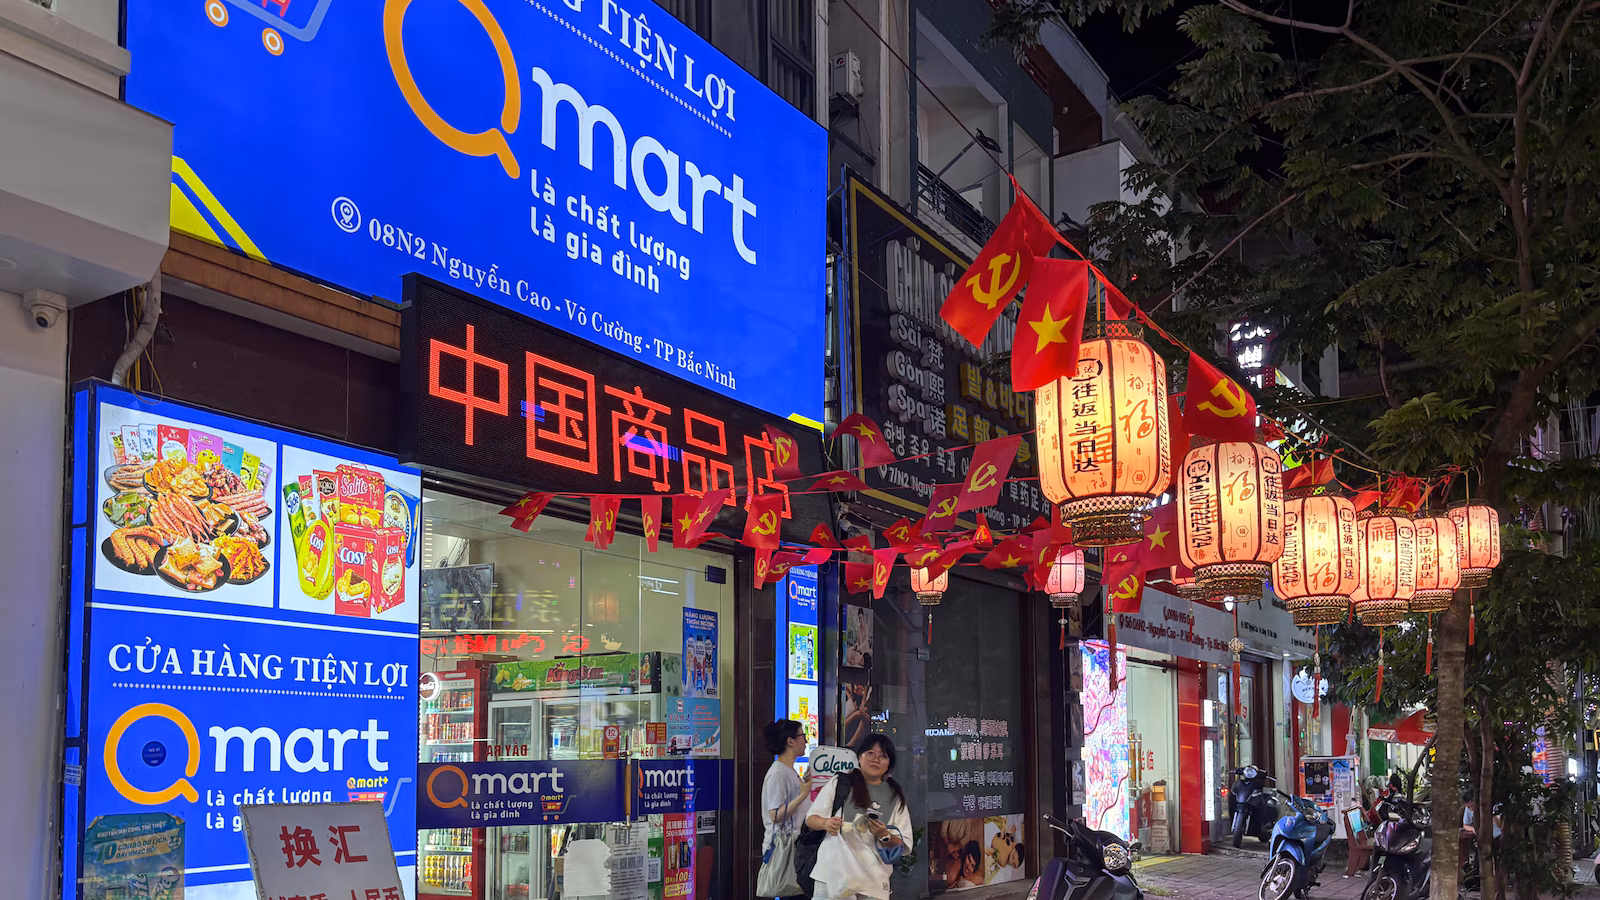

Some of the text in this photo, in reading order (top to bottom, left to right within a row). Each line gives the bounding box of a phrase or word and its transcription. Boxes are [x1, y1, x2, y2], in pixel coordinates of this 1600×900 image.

[598, 0, 736, 121] TIỆN LỢI
[384, 0, 757, 265] Qmart
[530, 169, 690, 281] là chất lượng
[530, 206, 660, 293] là gia đình
[368, 218, 426, 260] 08N2
[431, 242, 511, 296] Nguyễn
[516, 279, 551, 311] Cao
[564, 299, 588, 327] Võ
[591, 313, 643, 354] Cường
[653, 338, 674, 362] TP
[676, 341, 702, 376] Bắc
[704, 360, 737, 390] Ninh
[898, 314, 922, 350] Sài
[895, 350, 925, 387] Gòn
[968, 362, 982, 399] 발
[896, 384, 926, 421] Spa
[1072, 384, 1099, 473] 往返当日达
[340, 475, 368, 497] Solite
[912, 477, 936, 500] Nguyễ
[1264, 475, 1280, 545] 往返当日达
[310, 533, 324, 551] COSY
[340, 547, 366, 566] COSY
[386, 545, 399, 555] COSY
[1342, 523, 1355, 580] 往返当日达
[789, 580, 817, 600] Qmart
[1148, 621, 1166, 639] Nguyễn
[1166, 626, 1176, 640] Cao
[108, 636, 408, 693] CỬA HÀNG TIỆN LỢI
[104, 702, 390, 805] Qmart
[813, 753, 854, 774] Celano
[206, 789, 226, 806] là
[232, 787, 275, 805] chất
[426, 764, 564, 809] Qmart
[651, 792, 662, 800] chất
[206, 812, 225, 830] là
[471, 799, 533, 812] là chất lượng
[471, 809, 520, 821] là gia đình
[651, 801, 659, 809] gia
[280, 825, 368, 869] 换汇
